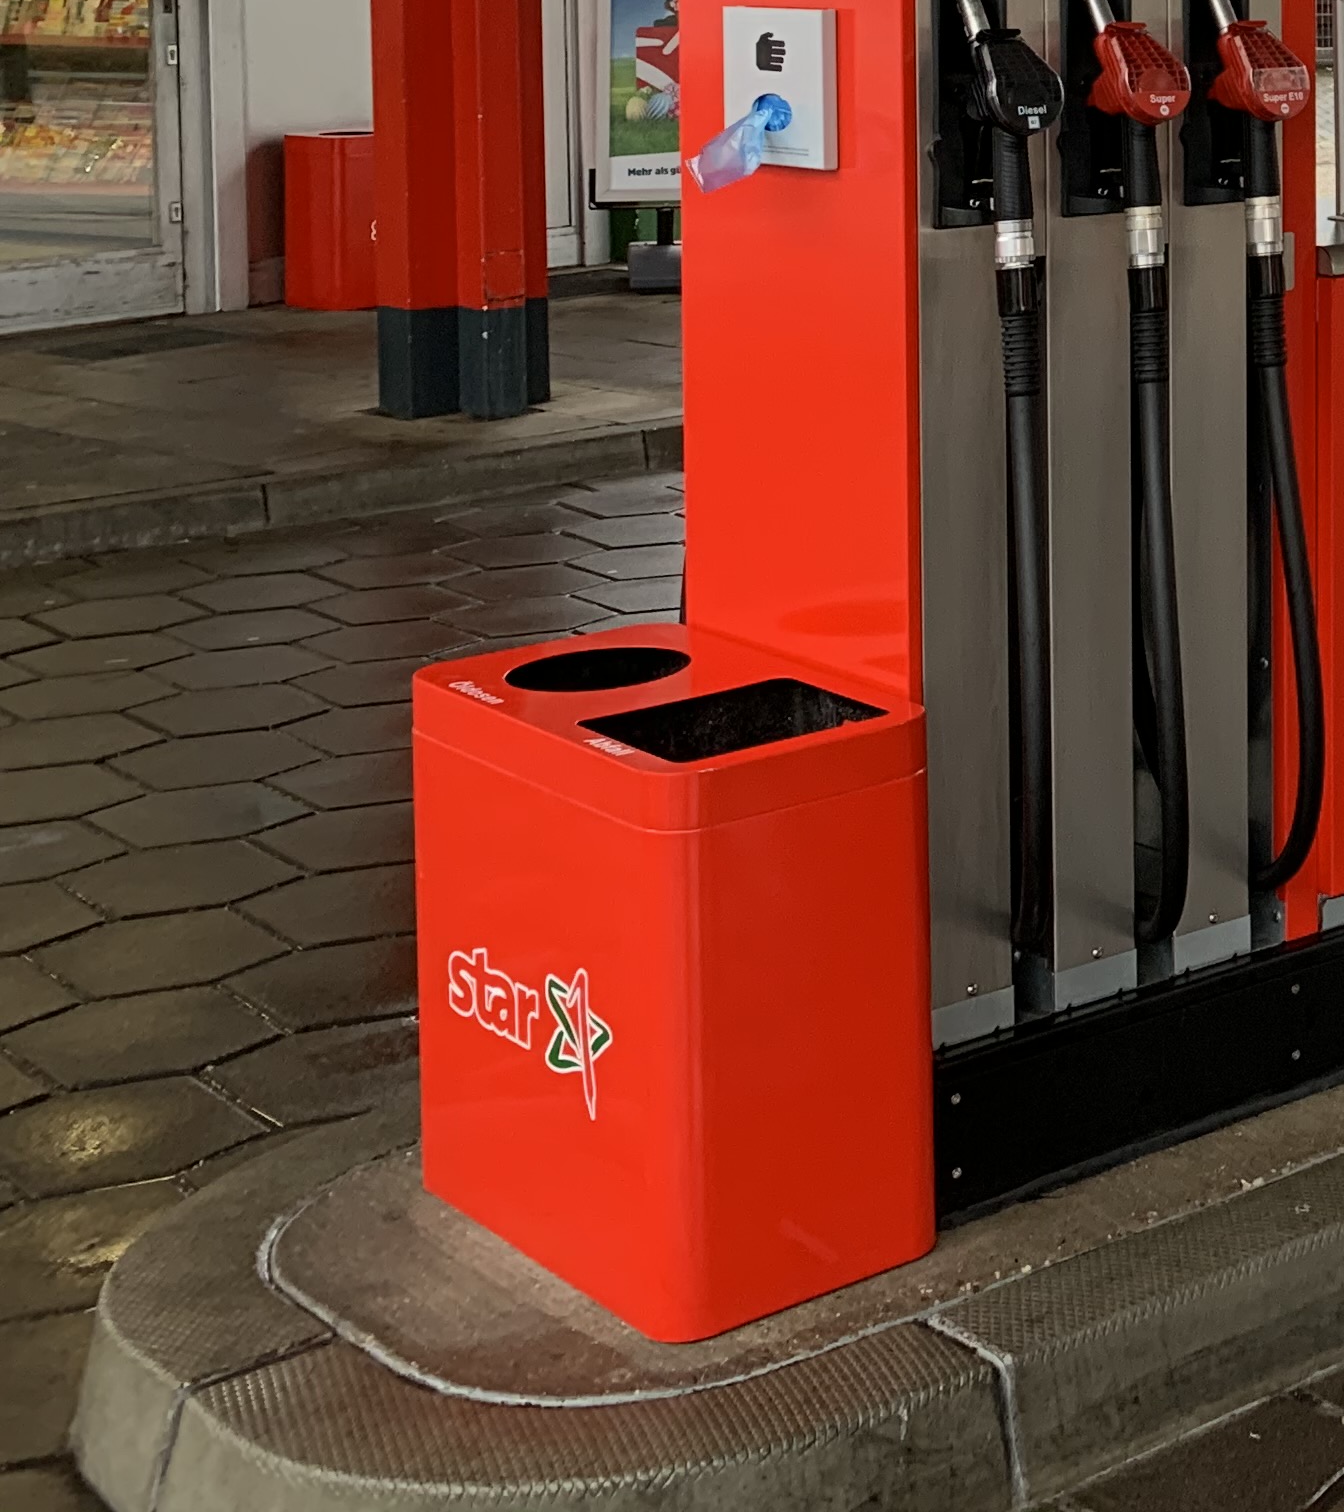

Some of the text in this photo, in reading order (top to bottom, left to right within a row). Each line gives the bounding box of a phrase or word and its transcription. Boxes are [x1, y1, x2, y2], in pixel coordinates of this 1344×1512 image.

[1150, 93, 1176, 104] Super
[1263, 91, 1304, 103] Super E10
[1017, 104, 1047, 116] Diesel
[628, 166, 652, 177] Mehr
[655, 166, 668, 176] als
[448, 680, 505, 705] Öldosen
[583, 737, 636, 756] Abfall
[448, 947, 540, 1050] star
